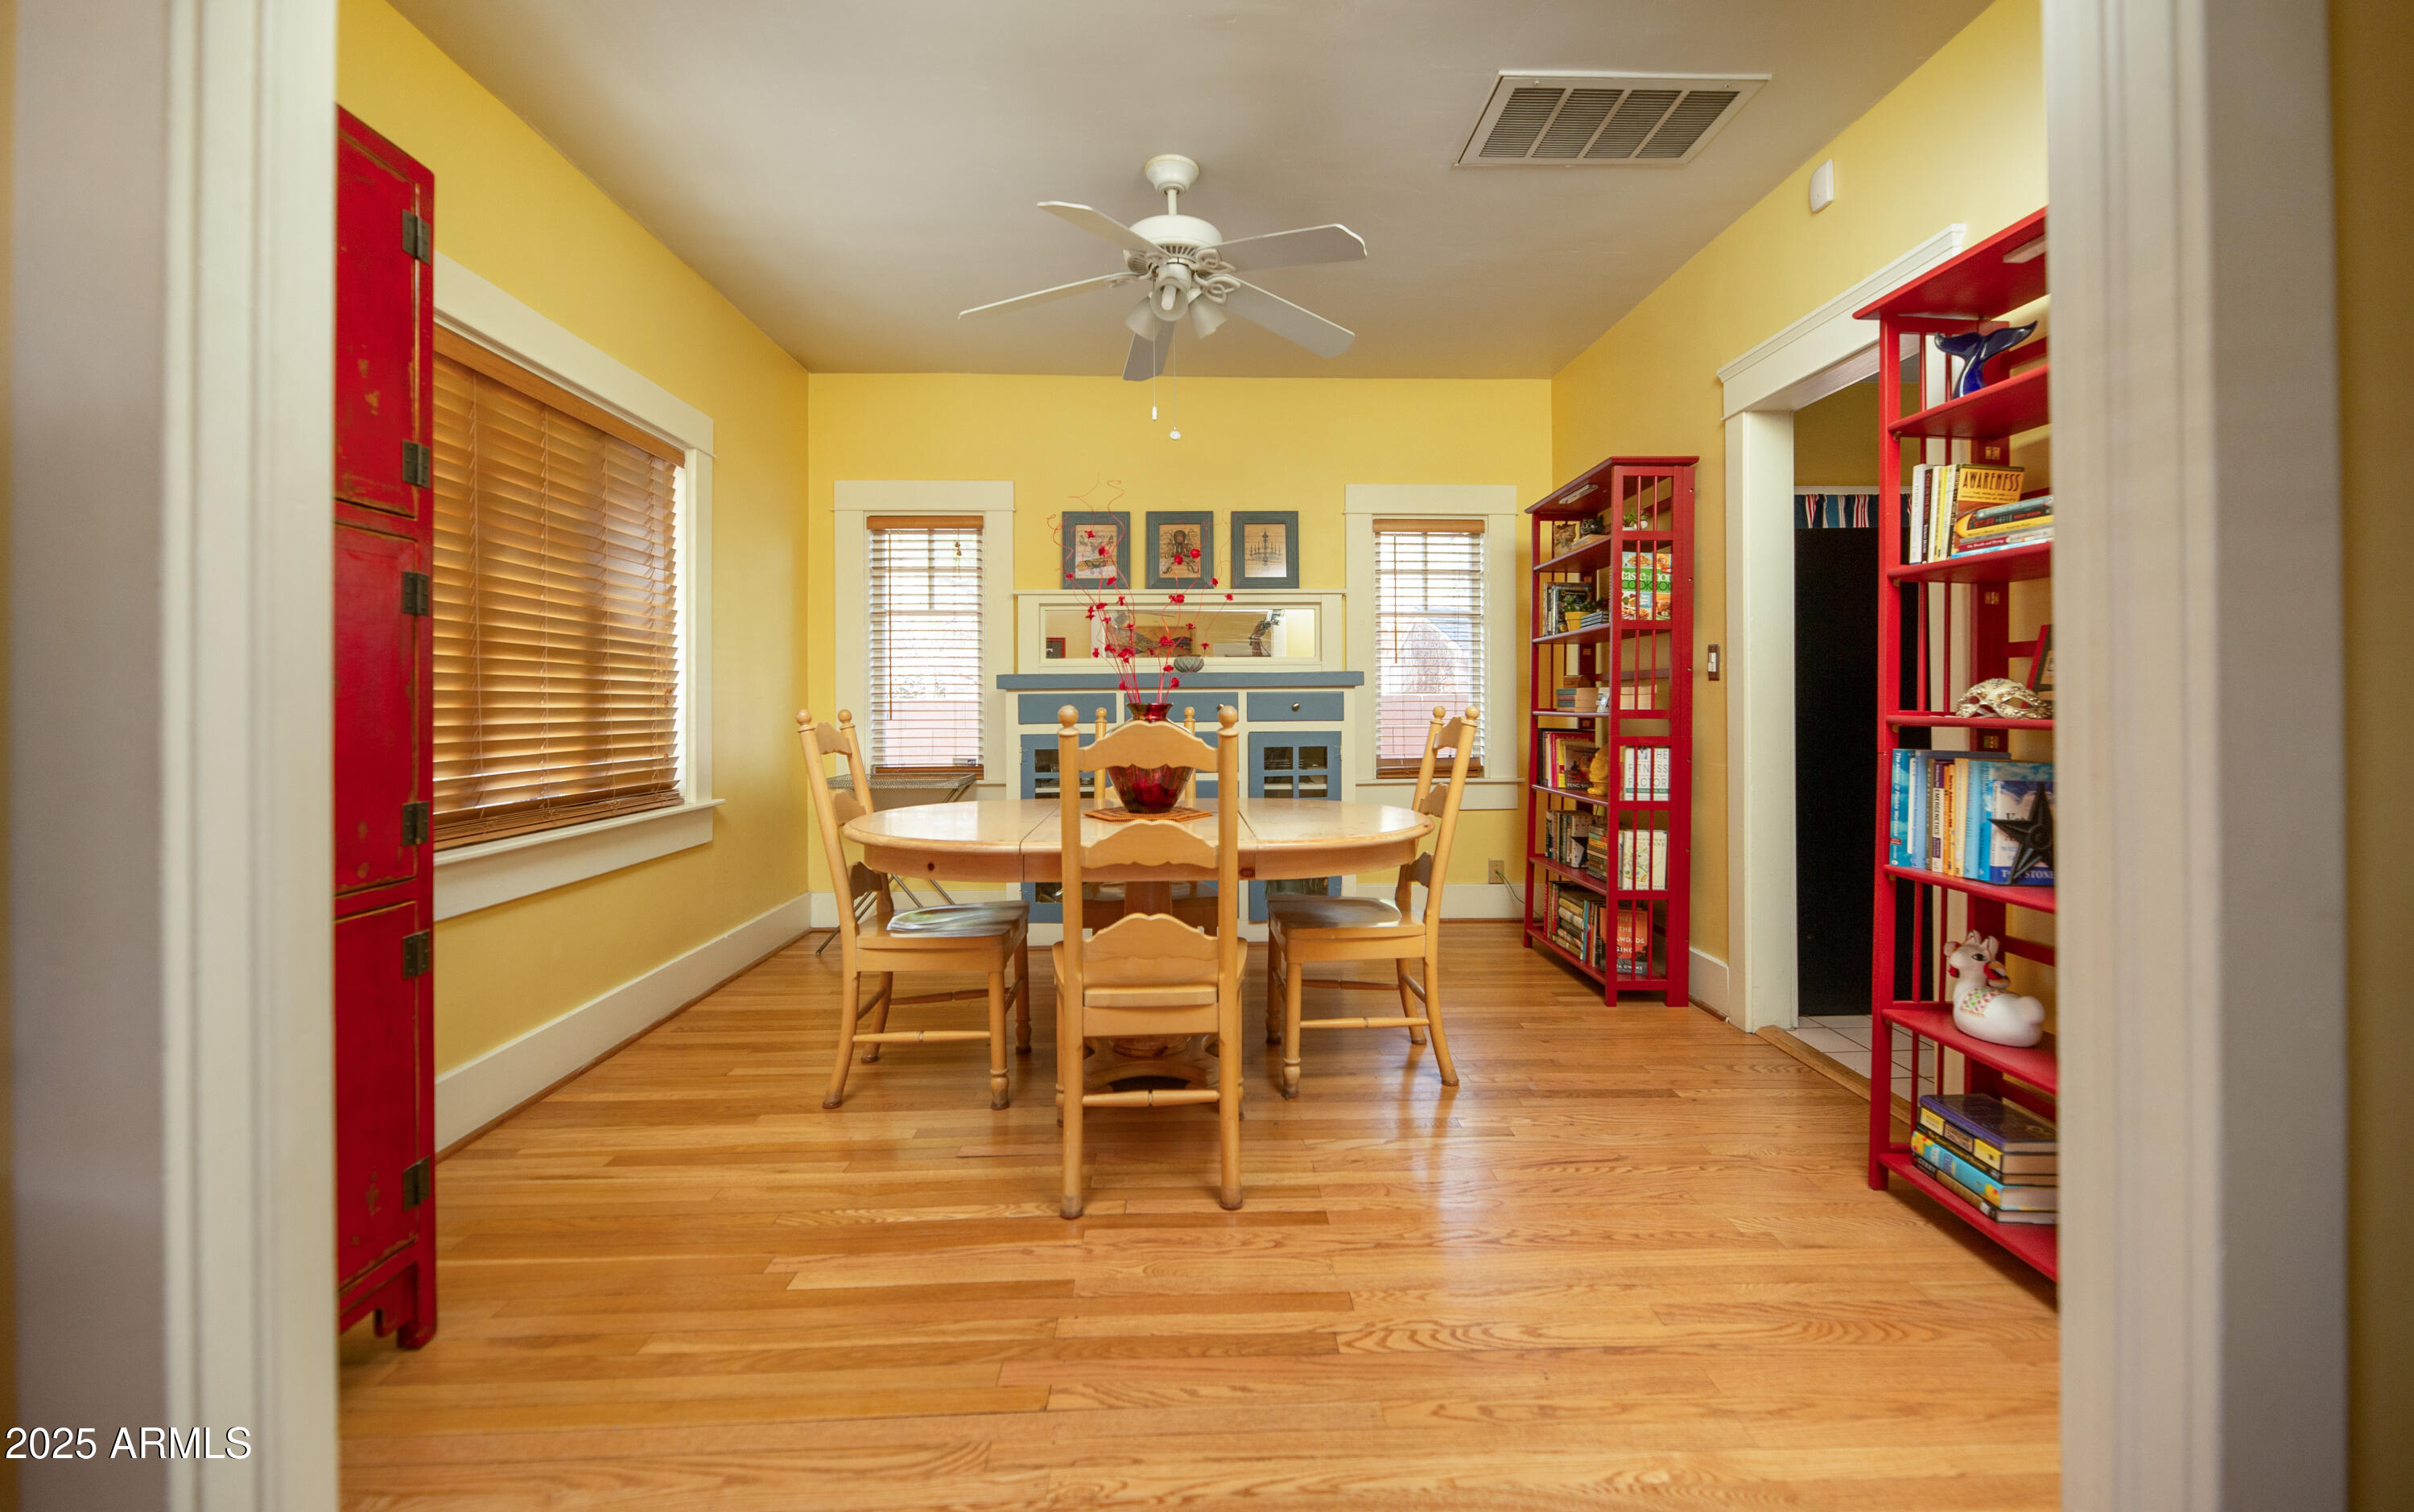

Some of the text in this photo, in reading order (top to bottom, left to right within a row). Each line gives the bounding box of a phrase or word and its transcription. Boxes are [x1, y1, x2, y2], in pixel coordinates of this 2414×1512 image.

[1962, 472, 2020, 492] AWARENESS
[1622, 571, 1646, 580] tase
[1628, 764, 1669, 773] FTNSS
